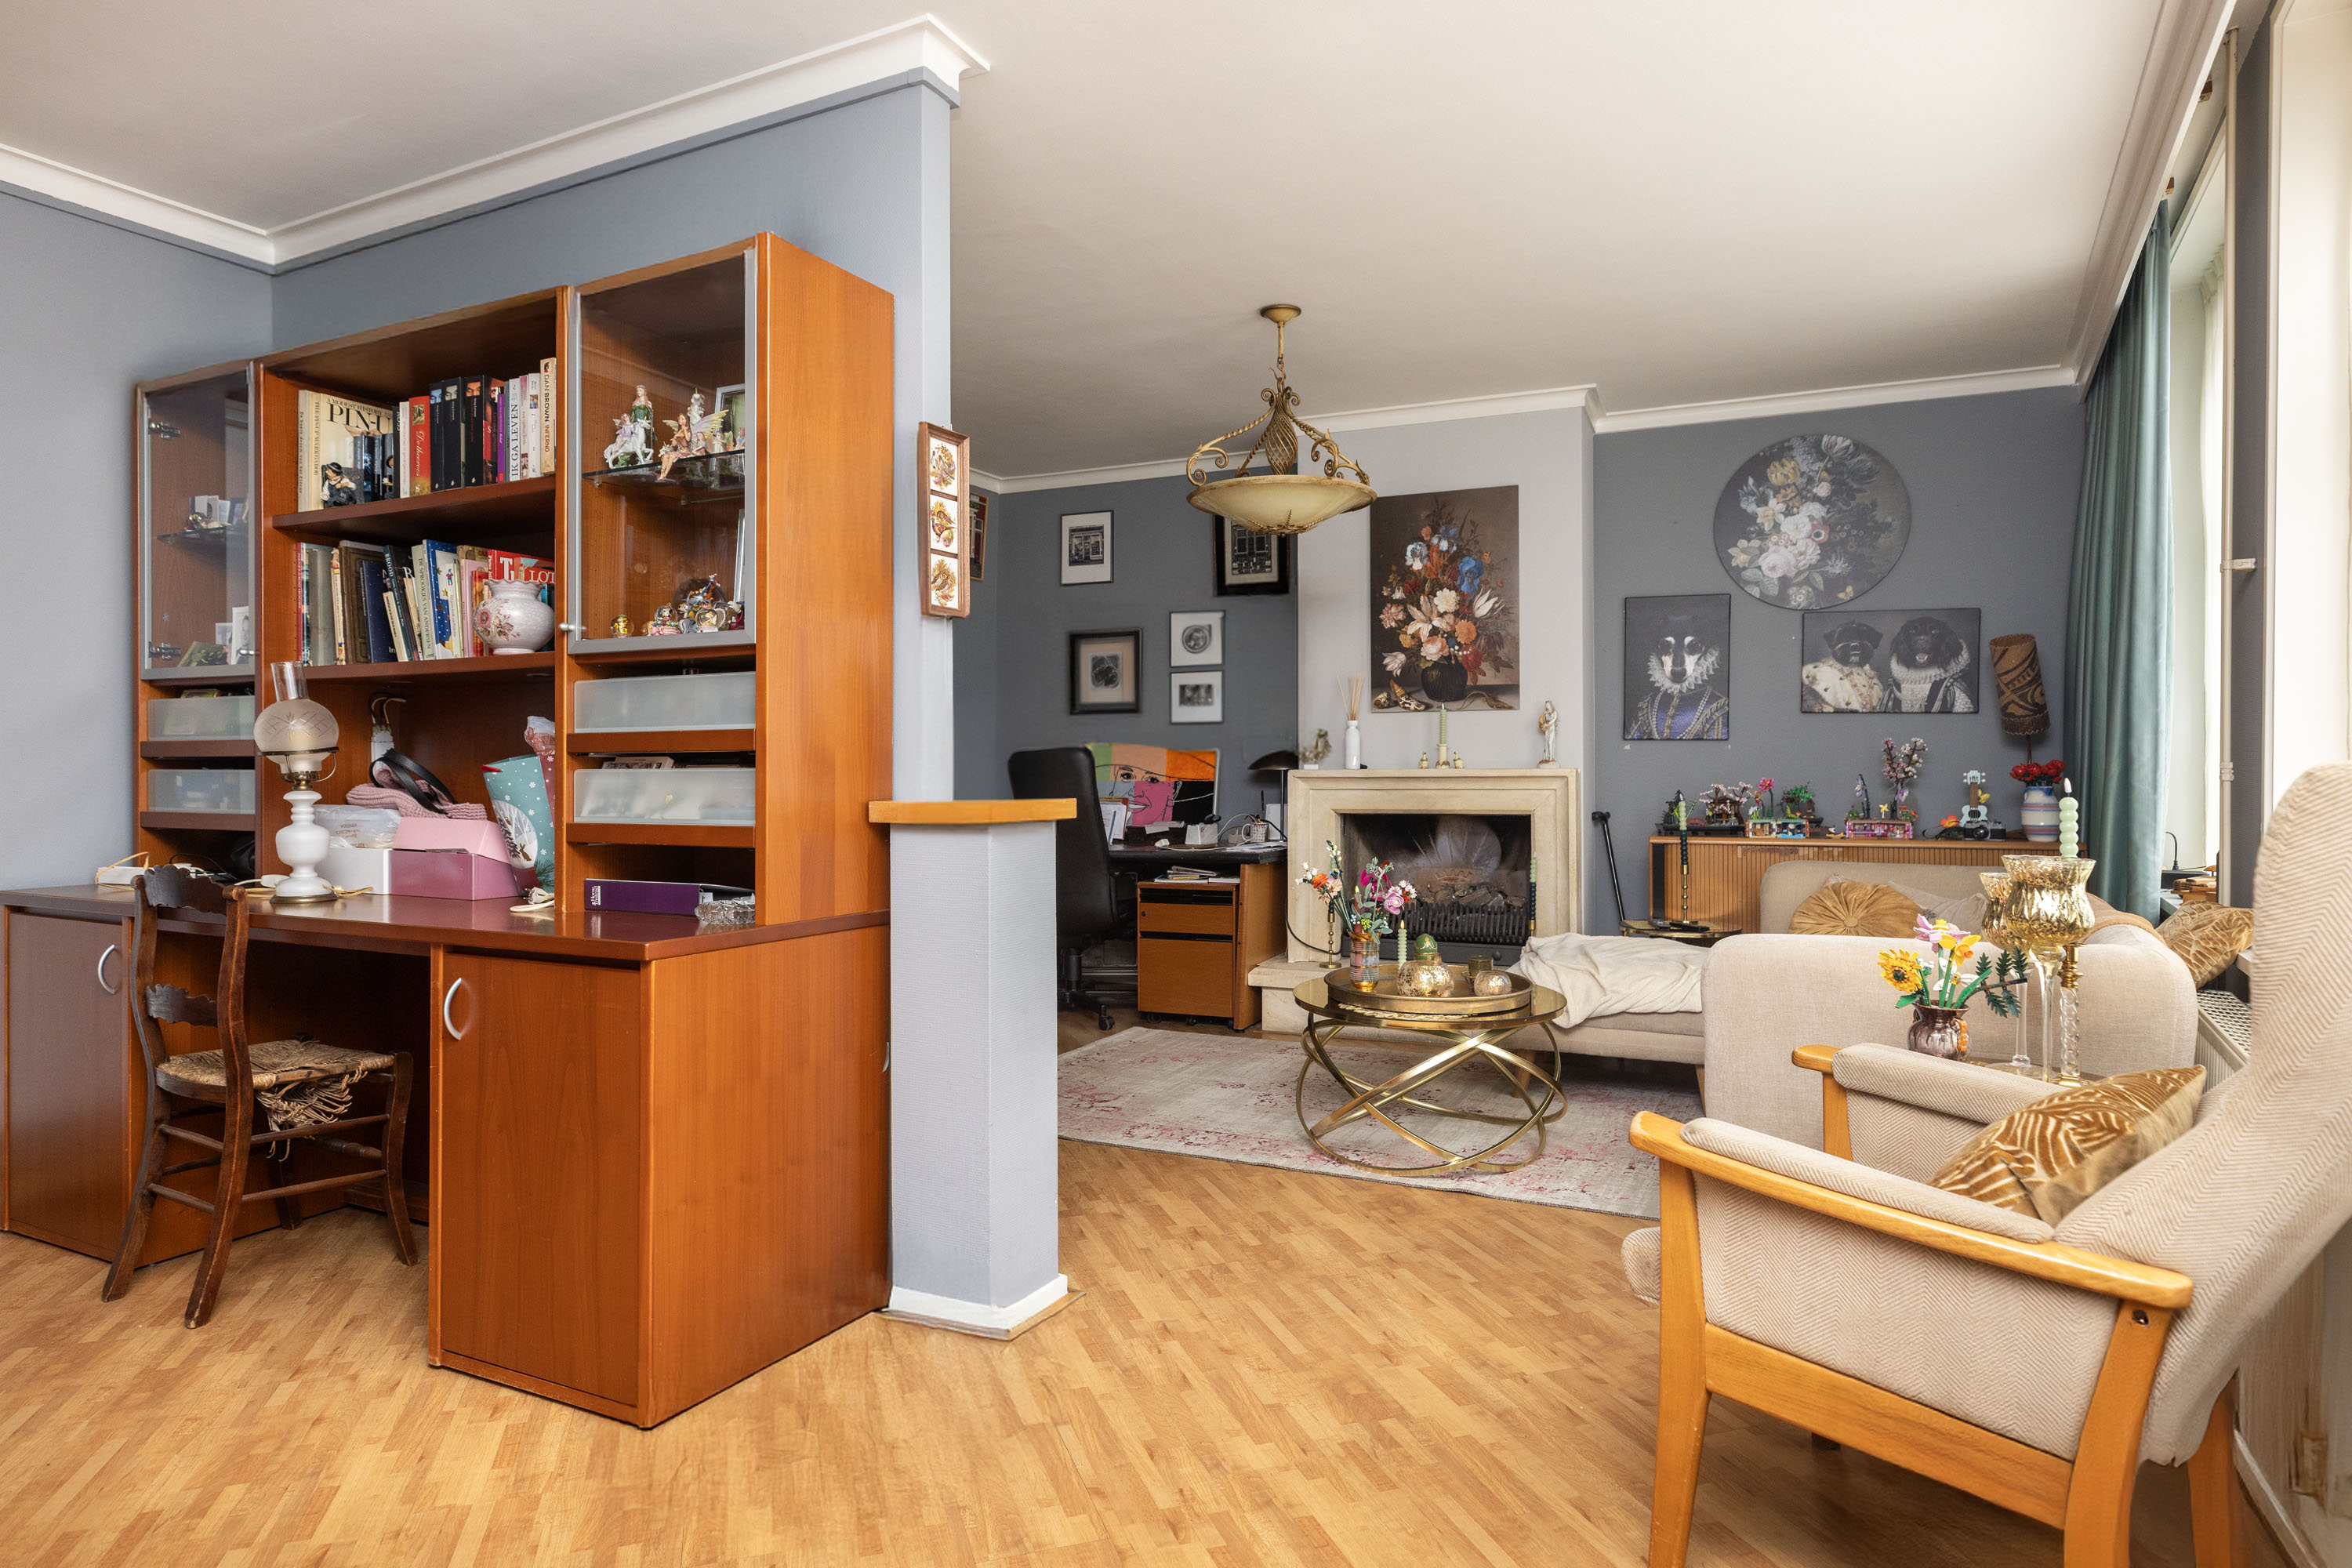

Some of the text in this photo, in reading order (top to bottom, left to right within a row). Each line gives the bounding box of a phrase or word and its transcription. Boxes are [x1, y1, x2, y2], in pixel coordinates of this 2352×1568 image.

[332, 399, 356, 408] MODEST
[357, 405, 382, 416] HISTORY
[326, 403, 393, 434] PIN-U
[416, 445, 424, 477] theeroos
[511, 445, 518, 461] GA
[511, 464, 518, 477] IK
[384, 553, 394, 577] BROOD
[418, 557, 423, 566] DE
